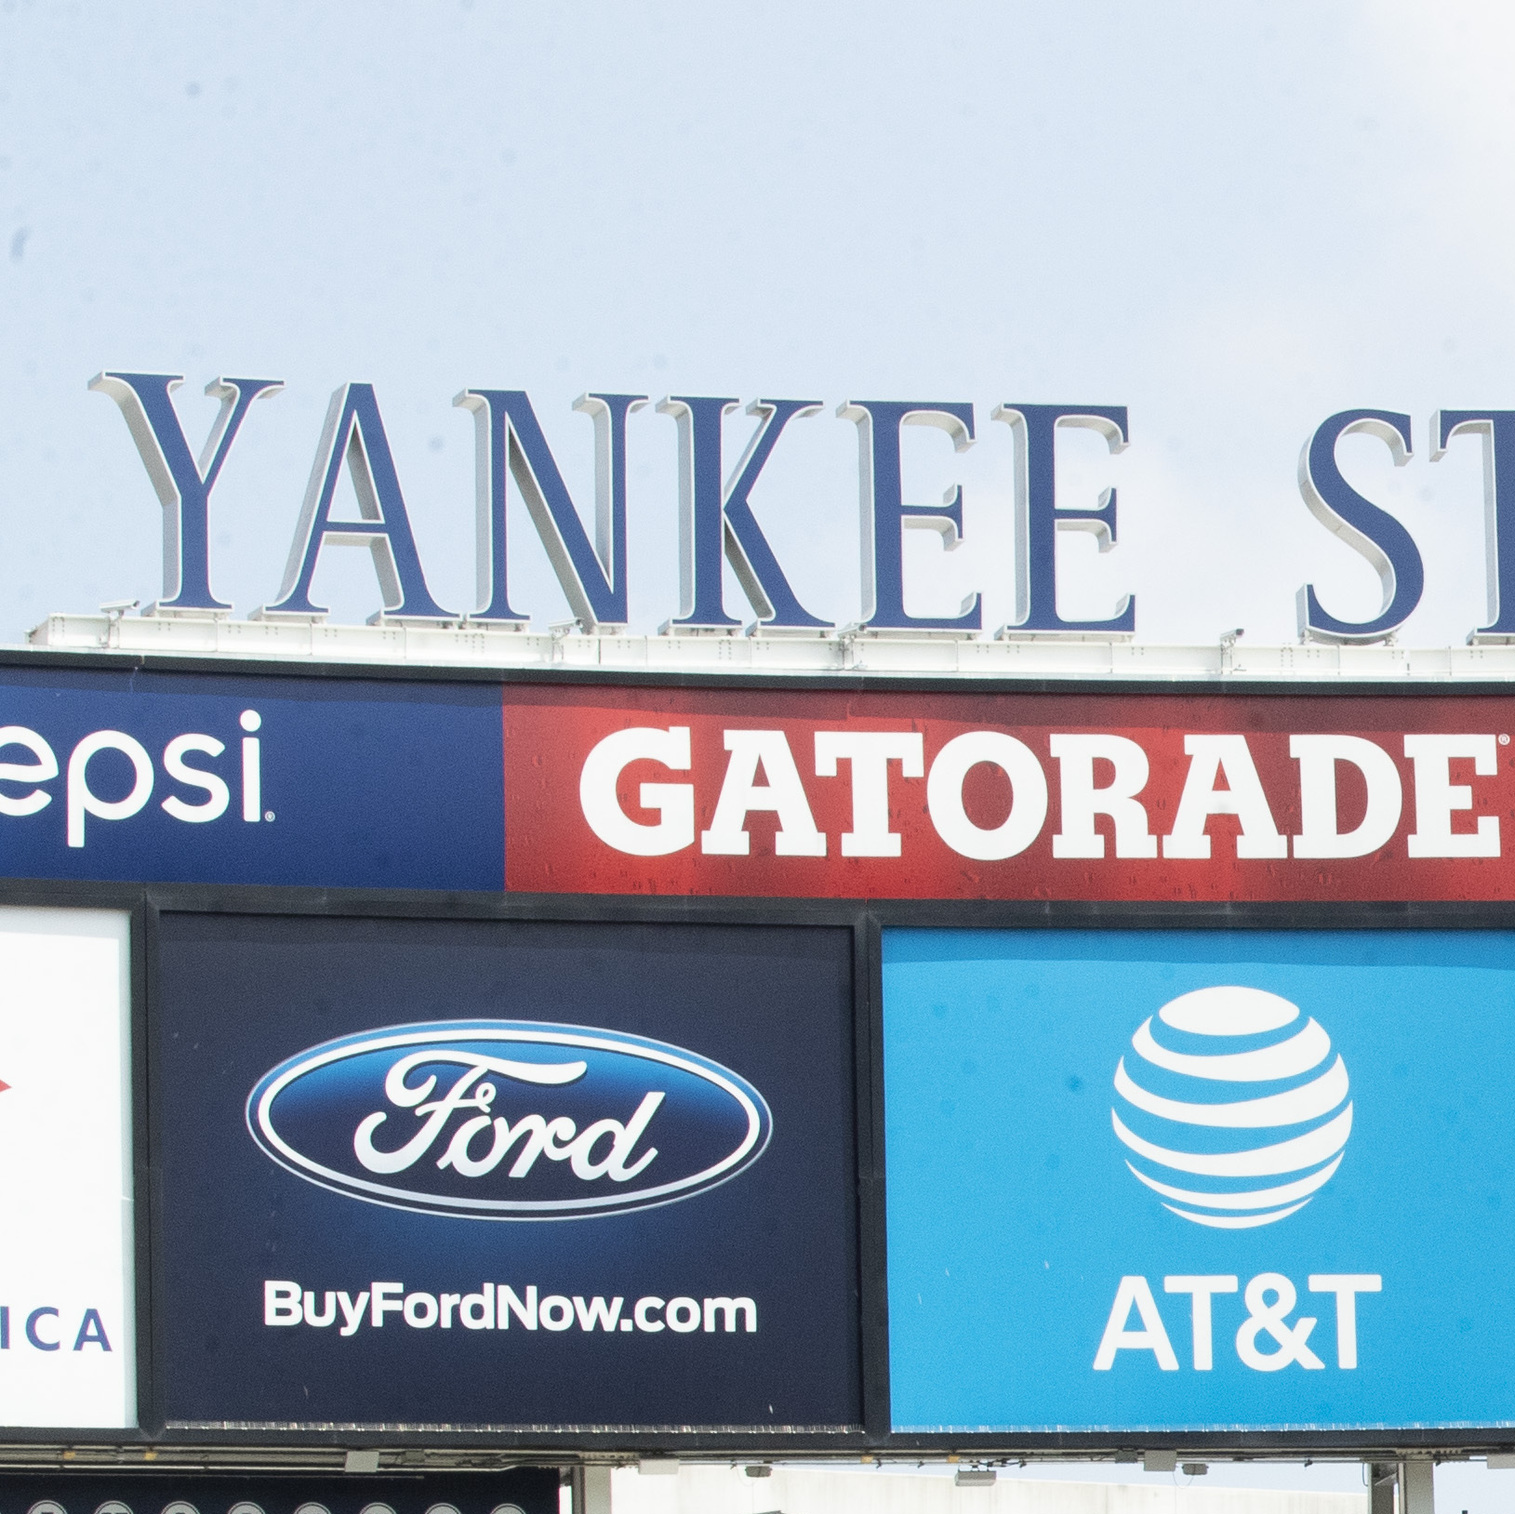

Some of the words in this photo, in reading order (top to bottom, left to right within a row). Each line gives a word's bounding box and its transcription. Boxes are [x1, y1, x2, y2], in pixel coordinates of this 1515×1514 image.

[89, 370, 1137, 637] YANKEE
[578, 724, 1501, 861] GATORADE
[352, 1049, 667, 1182] Ford
[263, 1280, 758, 1337] BuyFordNow.com
[1092, 1271, 1384, 1373] AT&T
